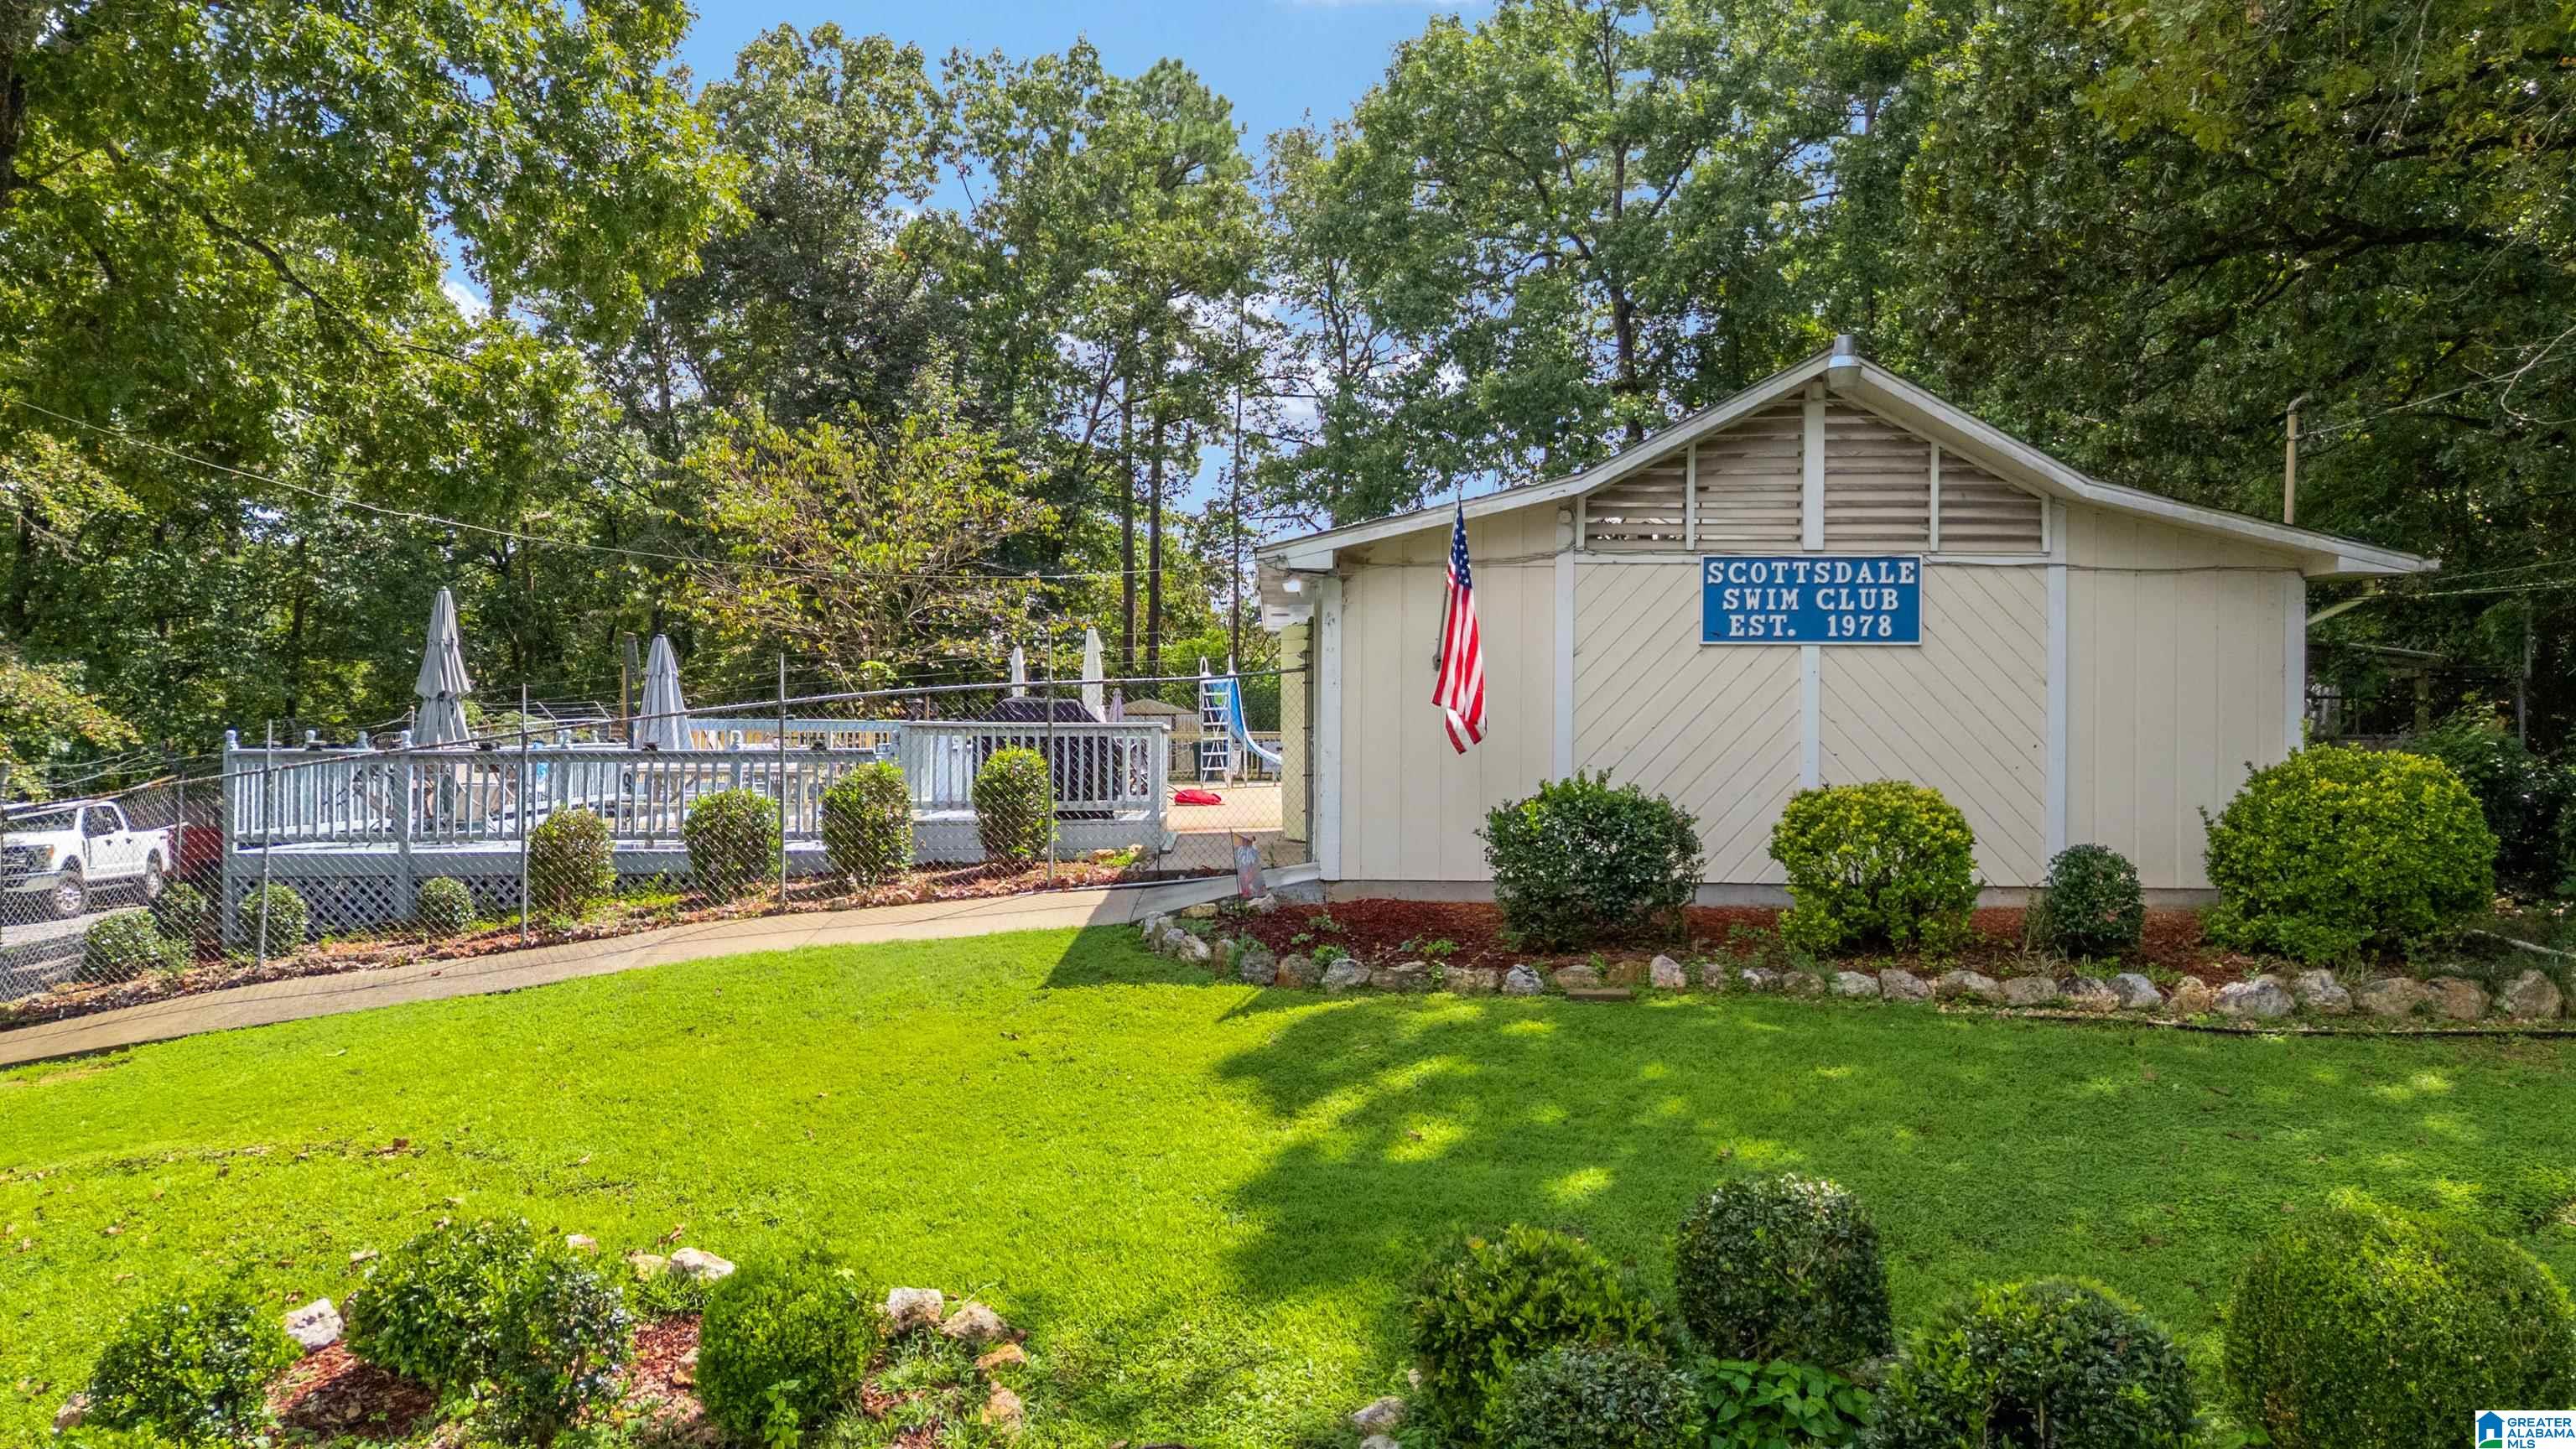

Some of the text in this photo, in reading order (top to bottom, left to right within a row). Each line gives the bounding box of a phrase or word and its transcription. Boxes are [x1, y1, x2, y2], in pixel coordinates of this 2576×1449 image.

[1707, 562, 1915, 584] SCOTTSDALE
[1722, 589, 1899, 610] SWIM CLUB
[1728, 614, 1893, 637] EST. 1978
